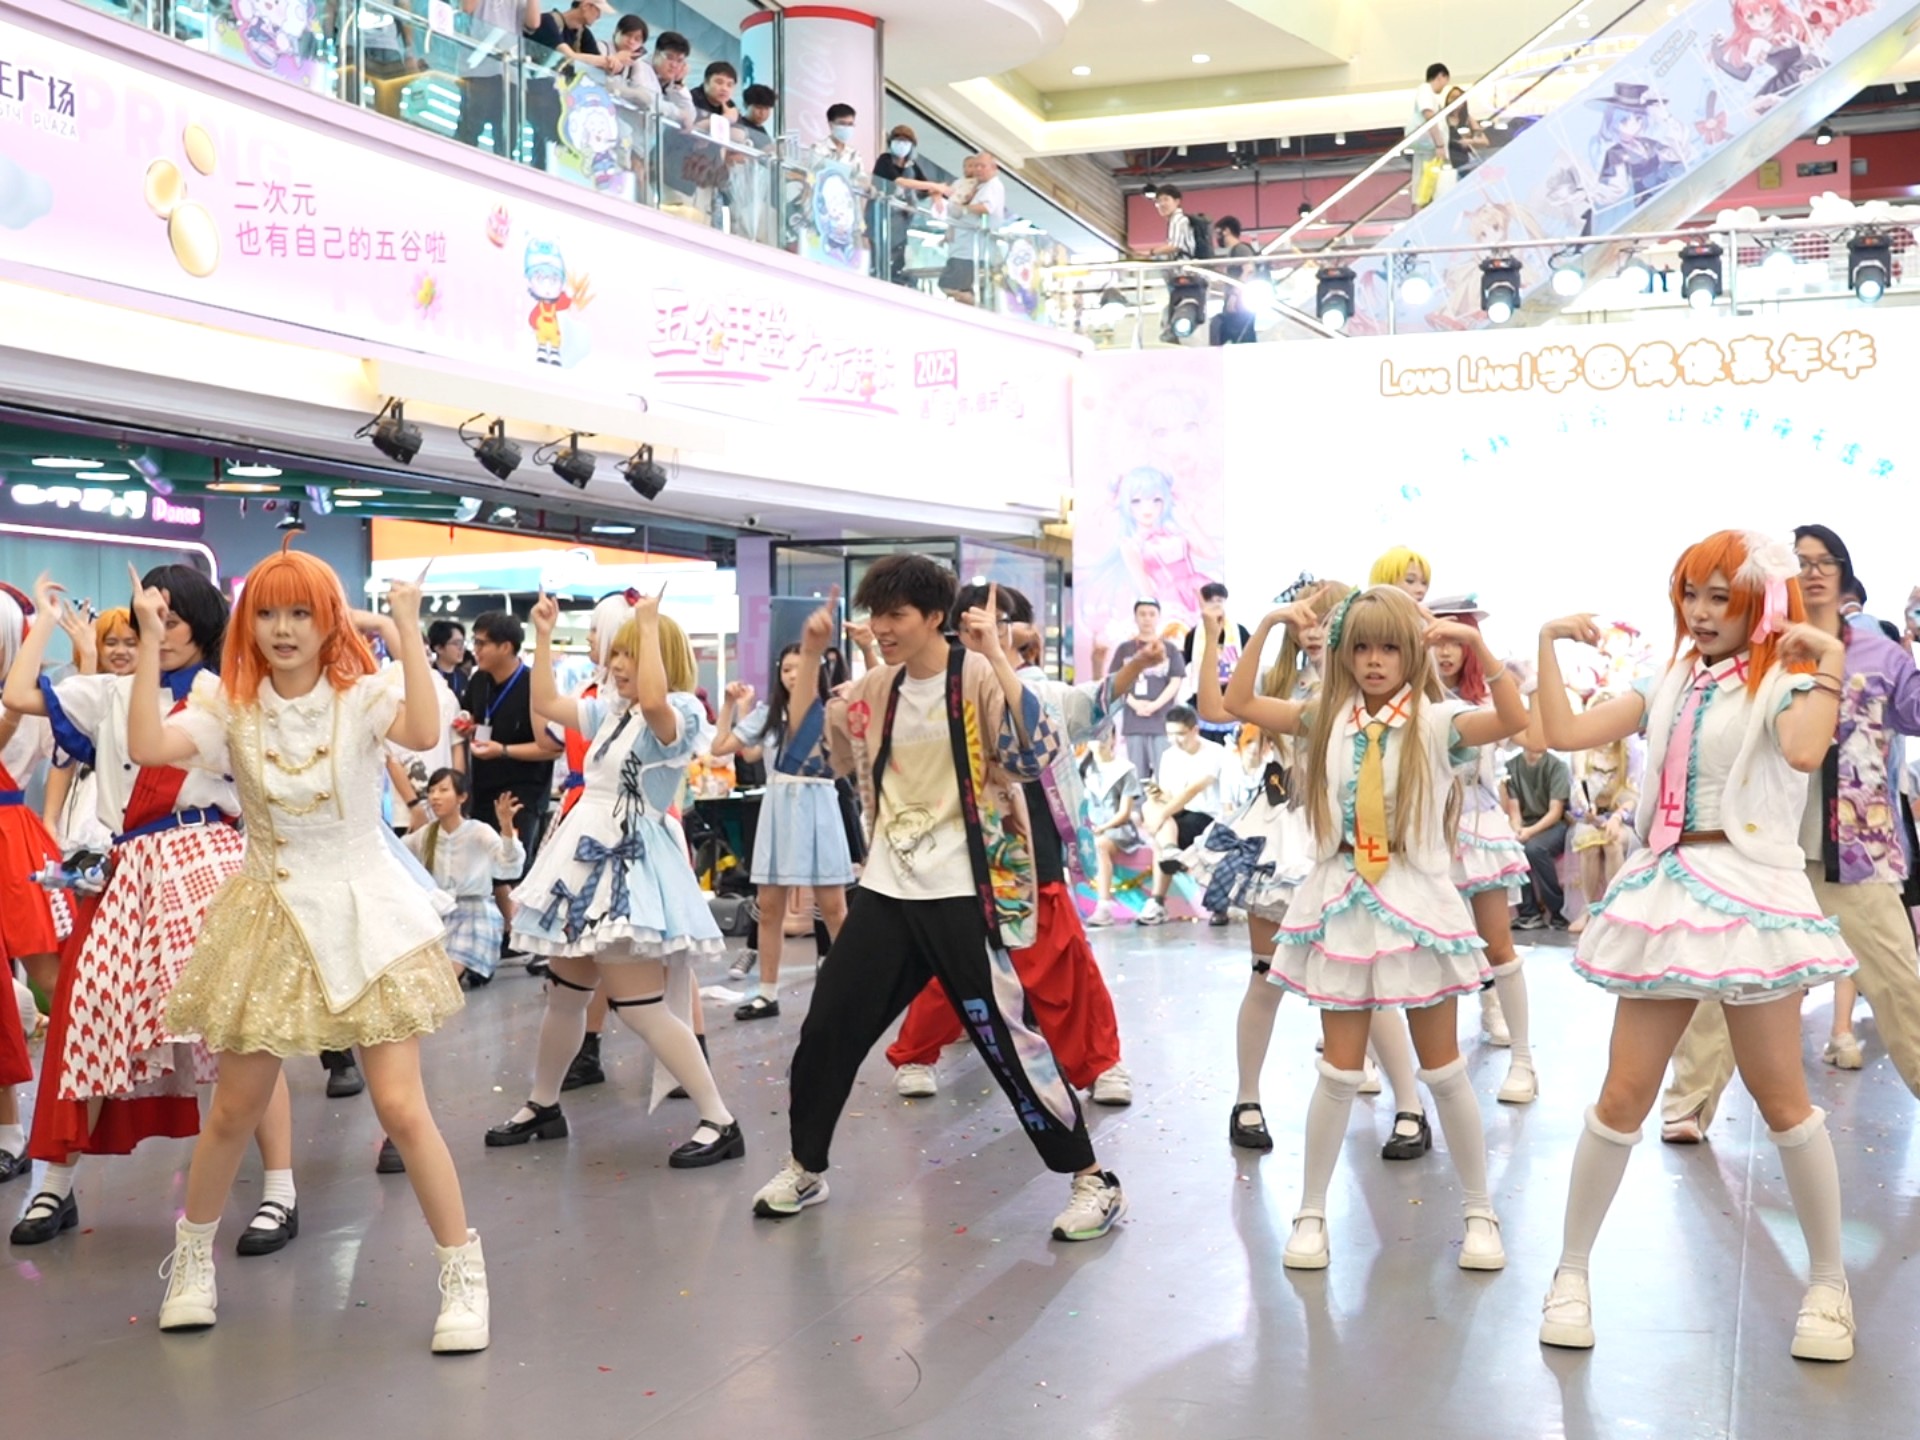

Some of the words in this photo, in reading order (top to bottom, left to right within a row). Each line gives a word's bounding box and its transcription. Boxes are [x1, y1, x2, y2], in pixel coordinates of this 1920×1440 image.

[33, 113, 78, 137] PLAZA
[234, 180, 317, 217] 二次元
[235, 221, 447, 264] 也有自己的五谷啦
[916, 352, 956, 385] 2025
[1380, 358, 1452, 397] Love
